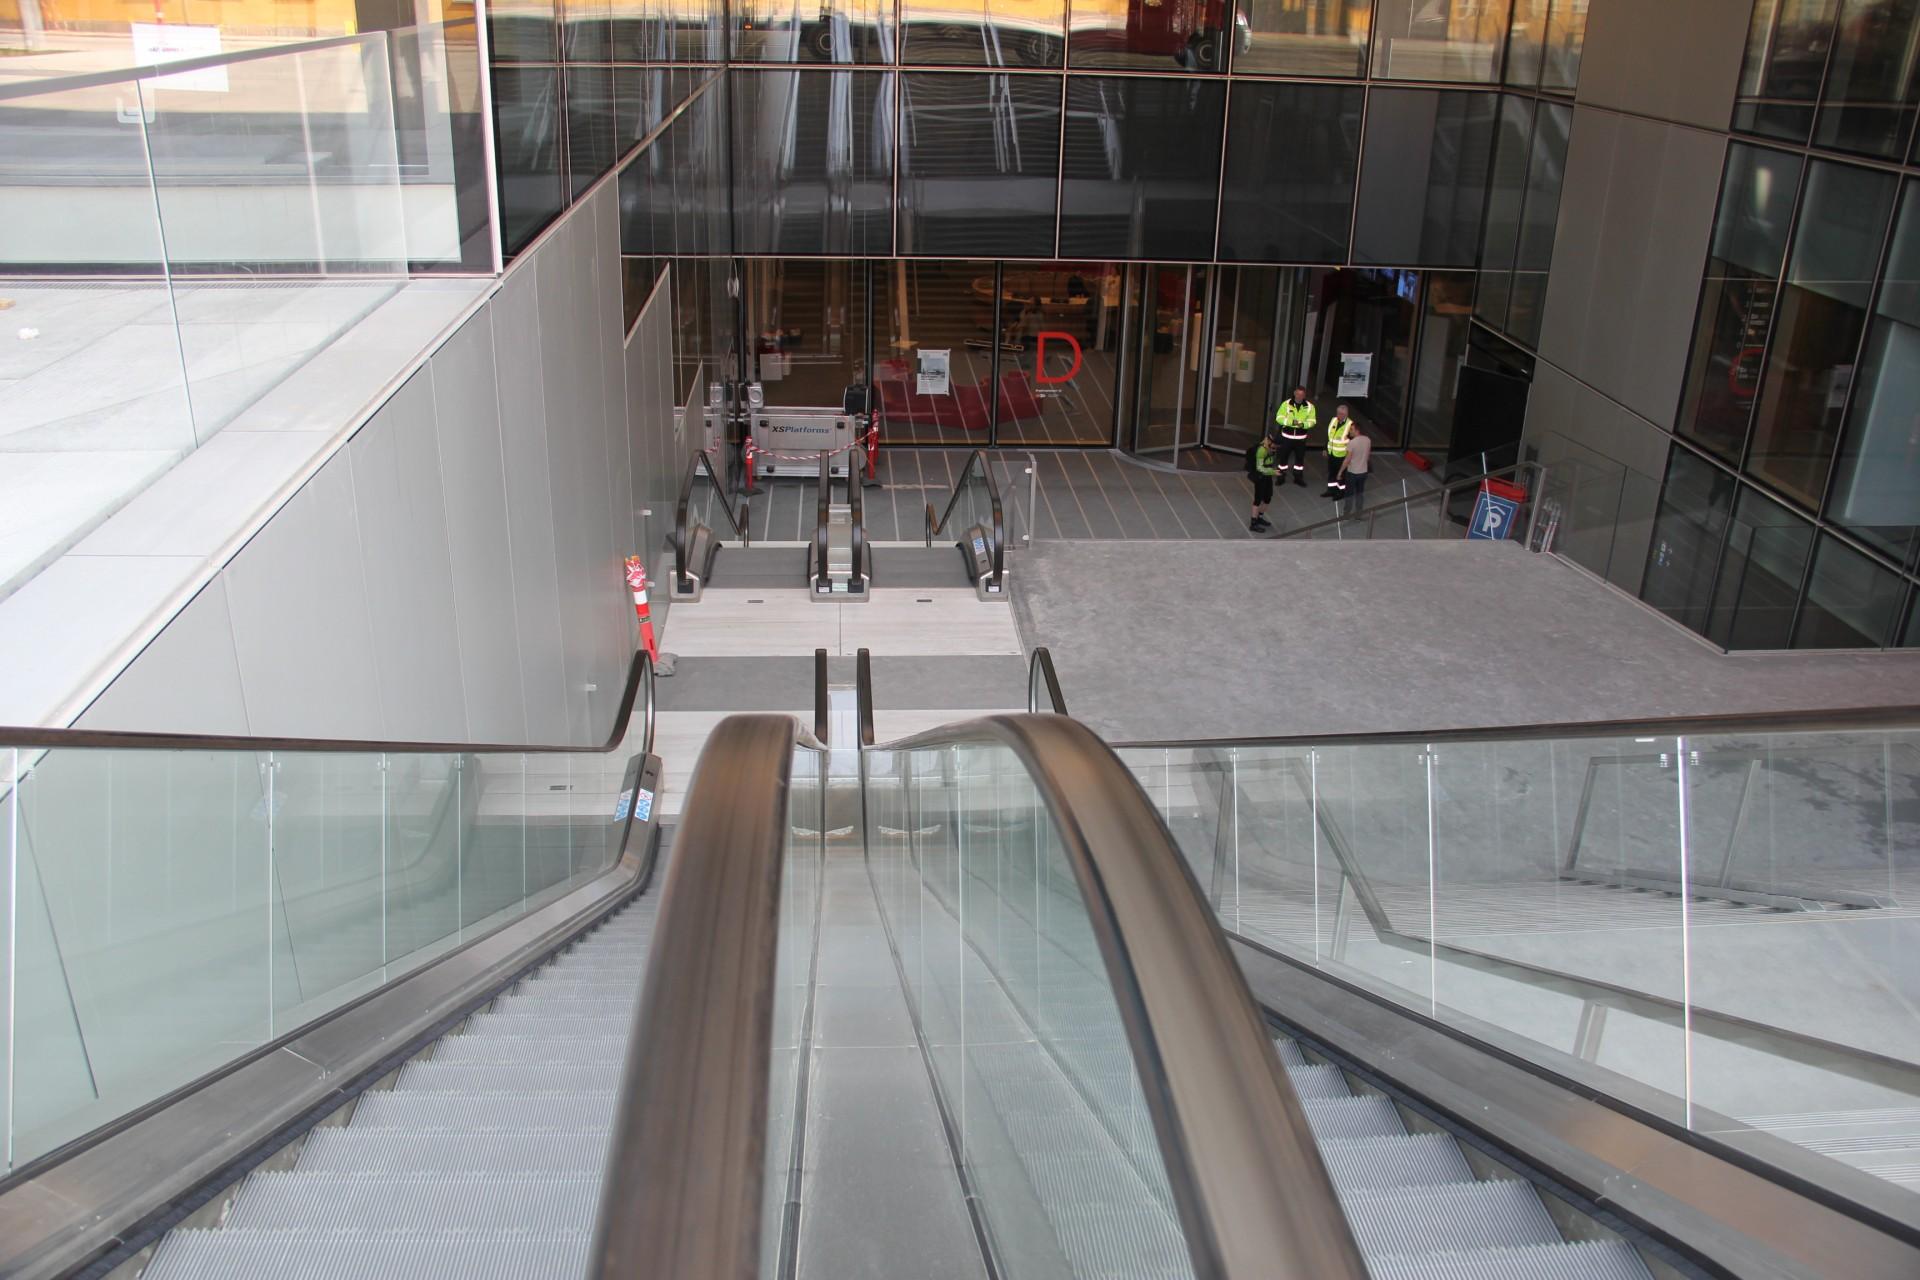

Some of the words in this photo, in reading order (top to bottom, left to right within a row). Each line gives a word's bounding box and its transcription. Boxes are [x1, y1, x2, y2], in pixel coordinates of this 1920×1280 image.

[1036, 332, 1082, 383] D
[772, 426, 830, 434] XSPlatforms
[1482, 512, 1502, 532] P
